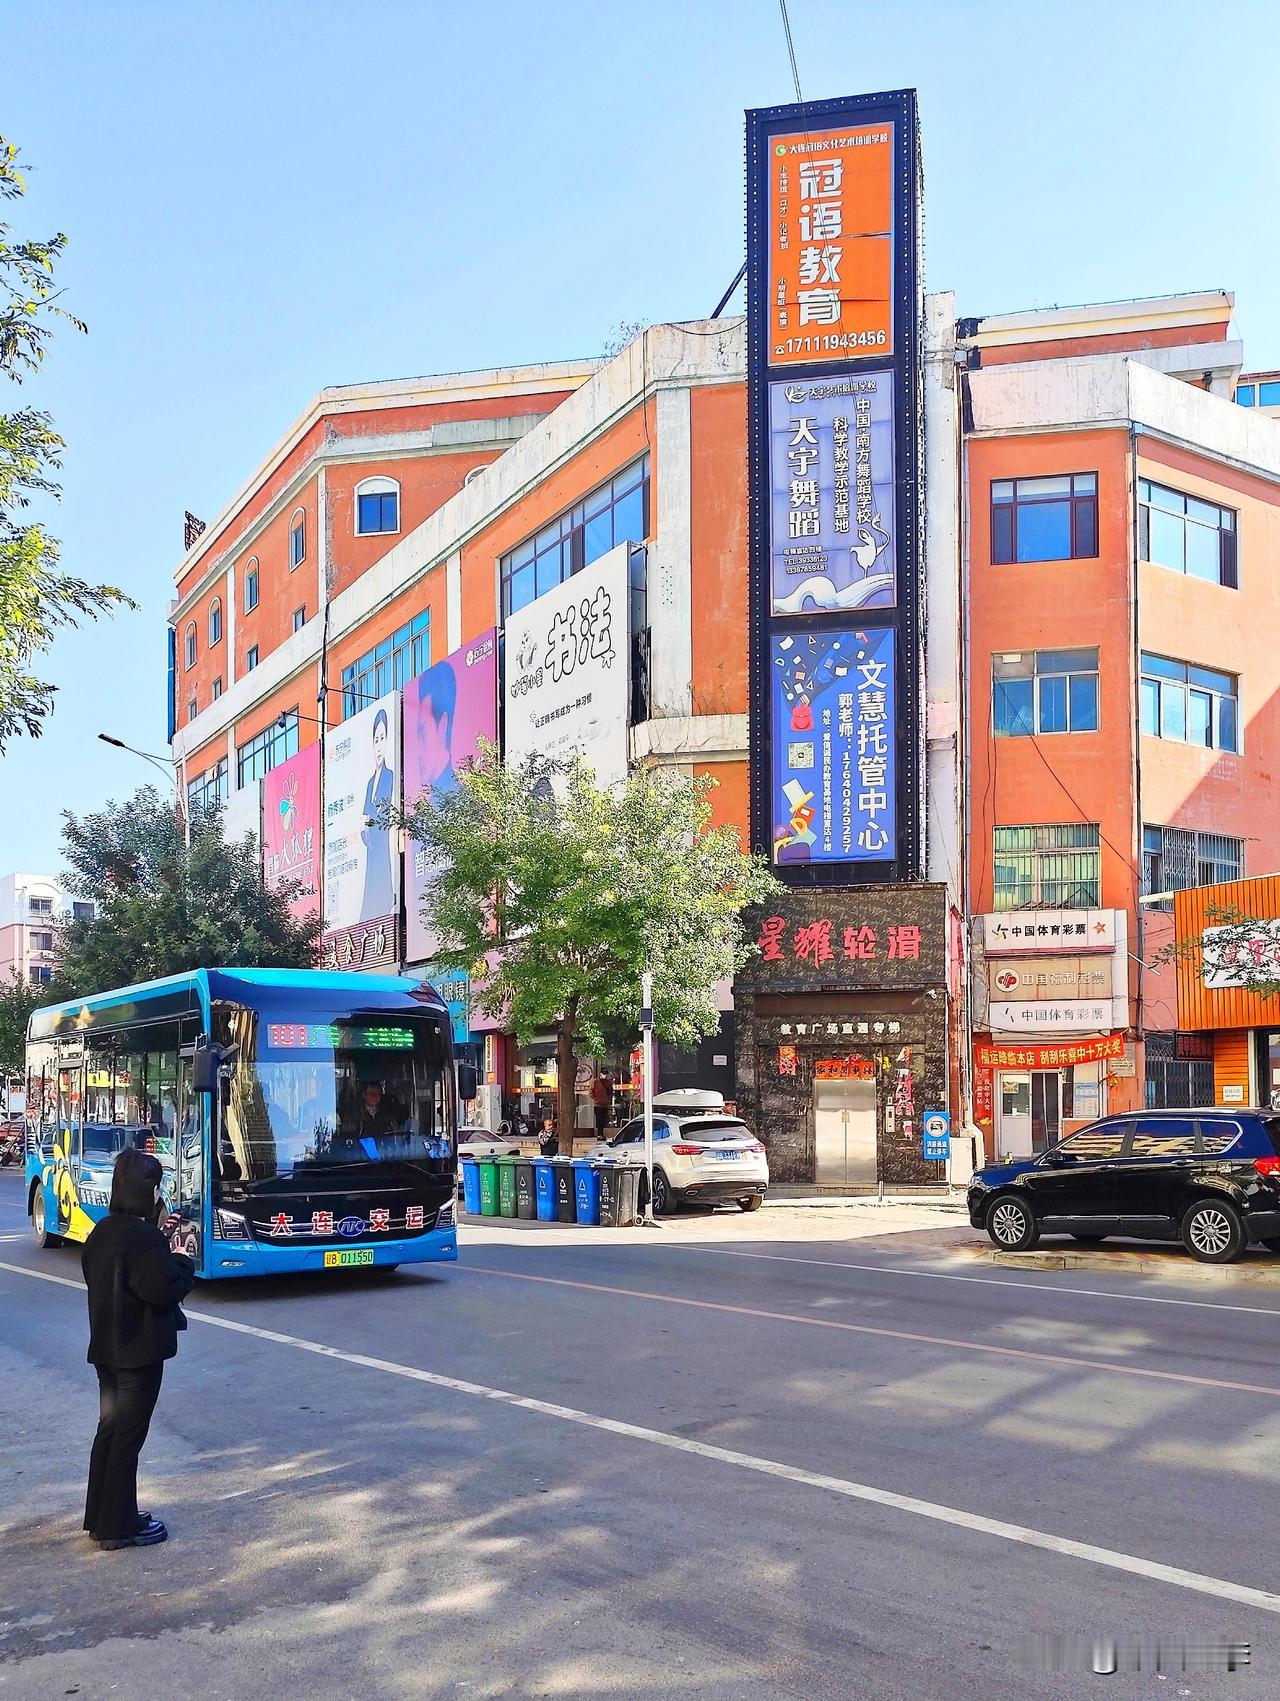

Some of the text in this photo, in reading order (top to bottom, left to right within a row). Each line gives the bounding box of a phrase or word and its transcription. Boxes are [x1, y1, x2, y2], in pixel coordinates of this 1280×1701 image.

[797, 158, 843, 326] 冠语教育
[786, 330, 886, 354] 17111943456
[788, 416, 820, 539] 天宇舞蹈
[833, 416, 850, 533] 科学教学示范基地
[545, 585, 615, 683] 书法
[857, 659, 889, 851] 文慧托管中心
[757, 915, 921, 969] 星耀轮滑
[1011, 923, 1087, 938] 中国体育彩票
[1021, 970, 1105, 987] 中国福利彩票
[1021, 1007, 1104, 1022] 中国体育彩票
[980, 1038, 1122, 1066] 福运降临本店 刮刮乐喜中十万大奖
